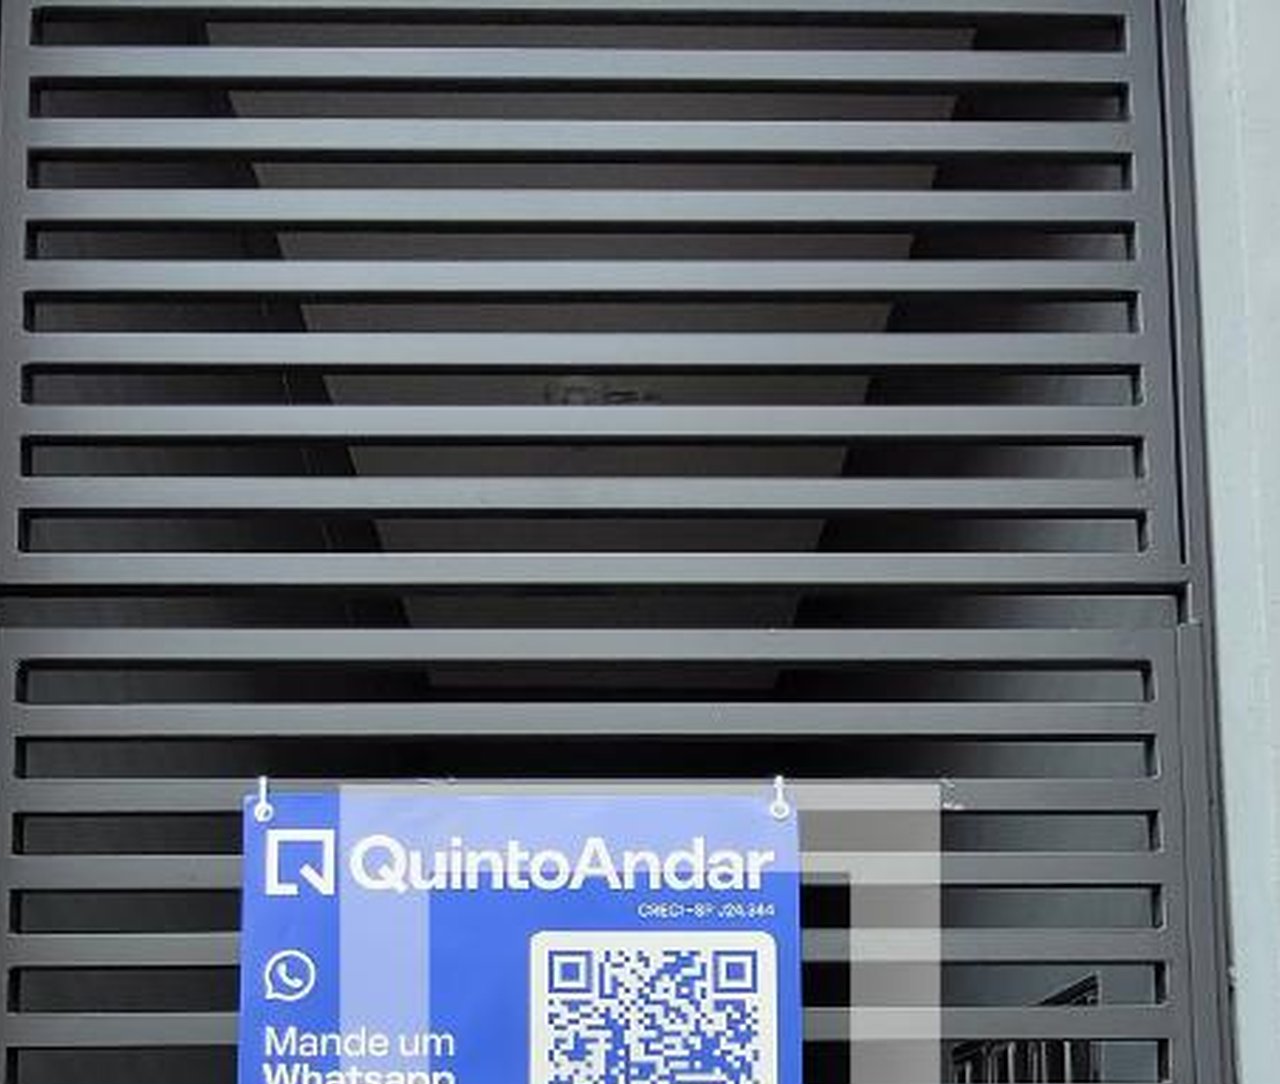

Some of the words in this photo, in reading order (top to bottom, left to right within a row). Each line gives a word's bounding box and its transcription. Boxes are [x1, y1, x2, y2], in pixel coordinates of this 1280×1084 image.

[349, 835, 775, 893] QuintoAndar
[264, 1026, 389, 1057] Mande
[400, 1033, 455, 1057] um
